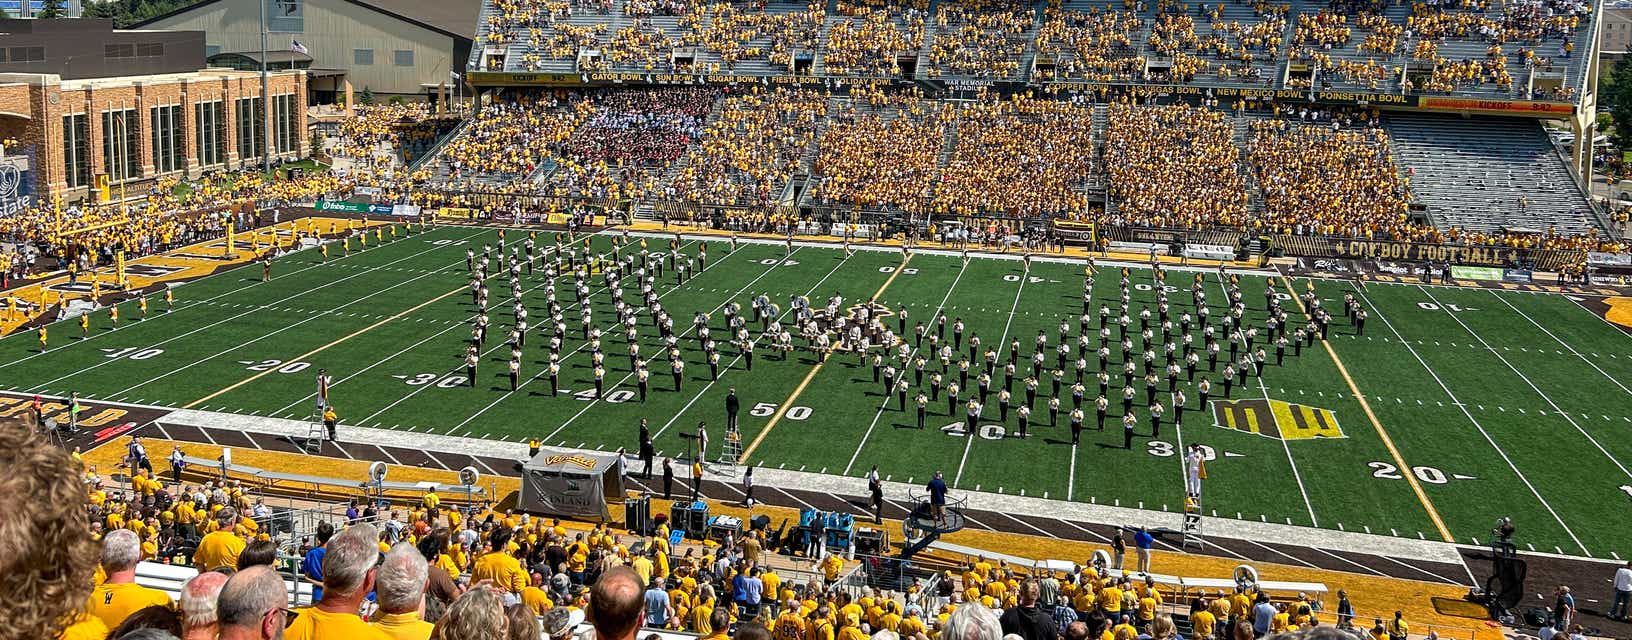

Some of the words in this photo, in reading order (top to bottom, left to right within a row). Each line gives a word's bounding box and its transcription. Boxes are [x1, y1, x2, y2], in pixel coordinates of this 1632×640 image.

[591, 73, 618, 81] GATOR
[1048, 83, 1084, 92] COPPER
[1125, 86, 1143, 94] LAS
[1145, 86, 1174, 94] VEGAS
[1176, 87, 1202, 95] BOWL
[1240, 90, 1274, 98] MEXICO
[1276, 91, 1304, 99] BOWL
[1318, 93, 1376, 102] POINSETTIA
[1379, 95, 1408, 103] BOWL
[1479, 101, 1512, 110] KICKOFF
[1417, 244, 1503, 265] FOOTBALL
[103, 347, 165, 360] 10
[245, 359, 312, 373] 20
[405, 373, 469, 388] 30
[573, 388, 636, 403] 40
[749, 402, 814, 420] 50
[940, 422, 1006, 440] 40
[1147, 441, 1217, 461] 30
[1367, 461, 1448, 484] 20
[549, 495, 591, 506] INLAND
[104, 592, 114, 605] W
